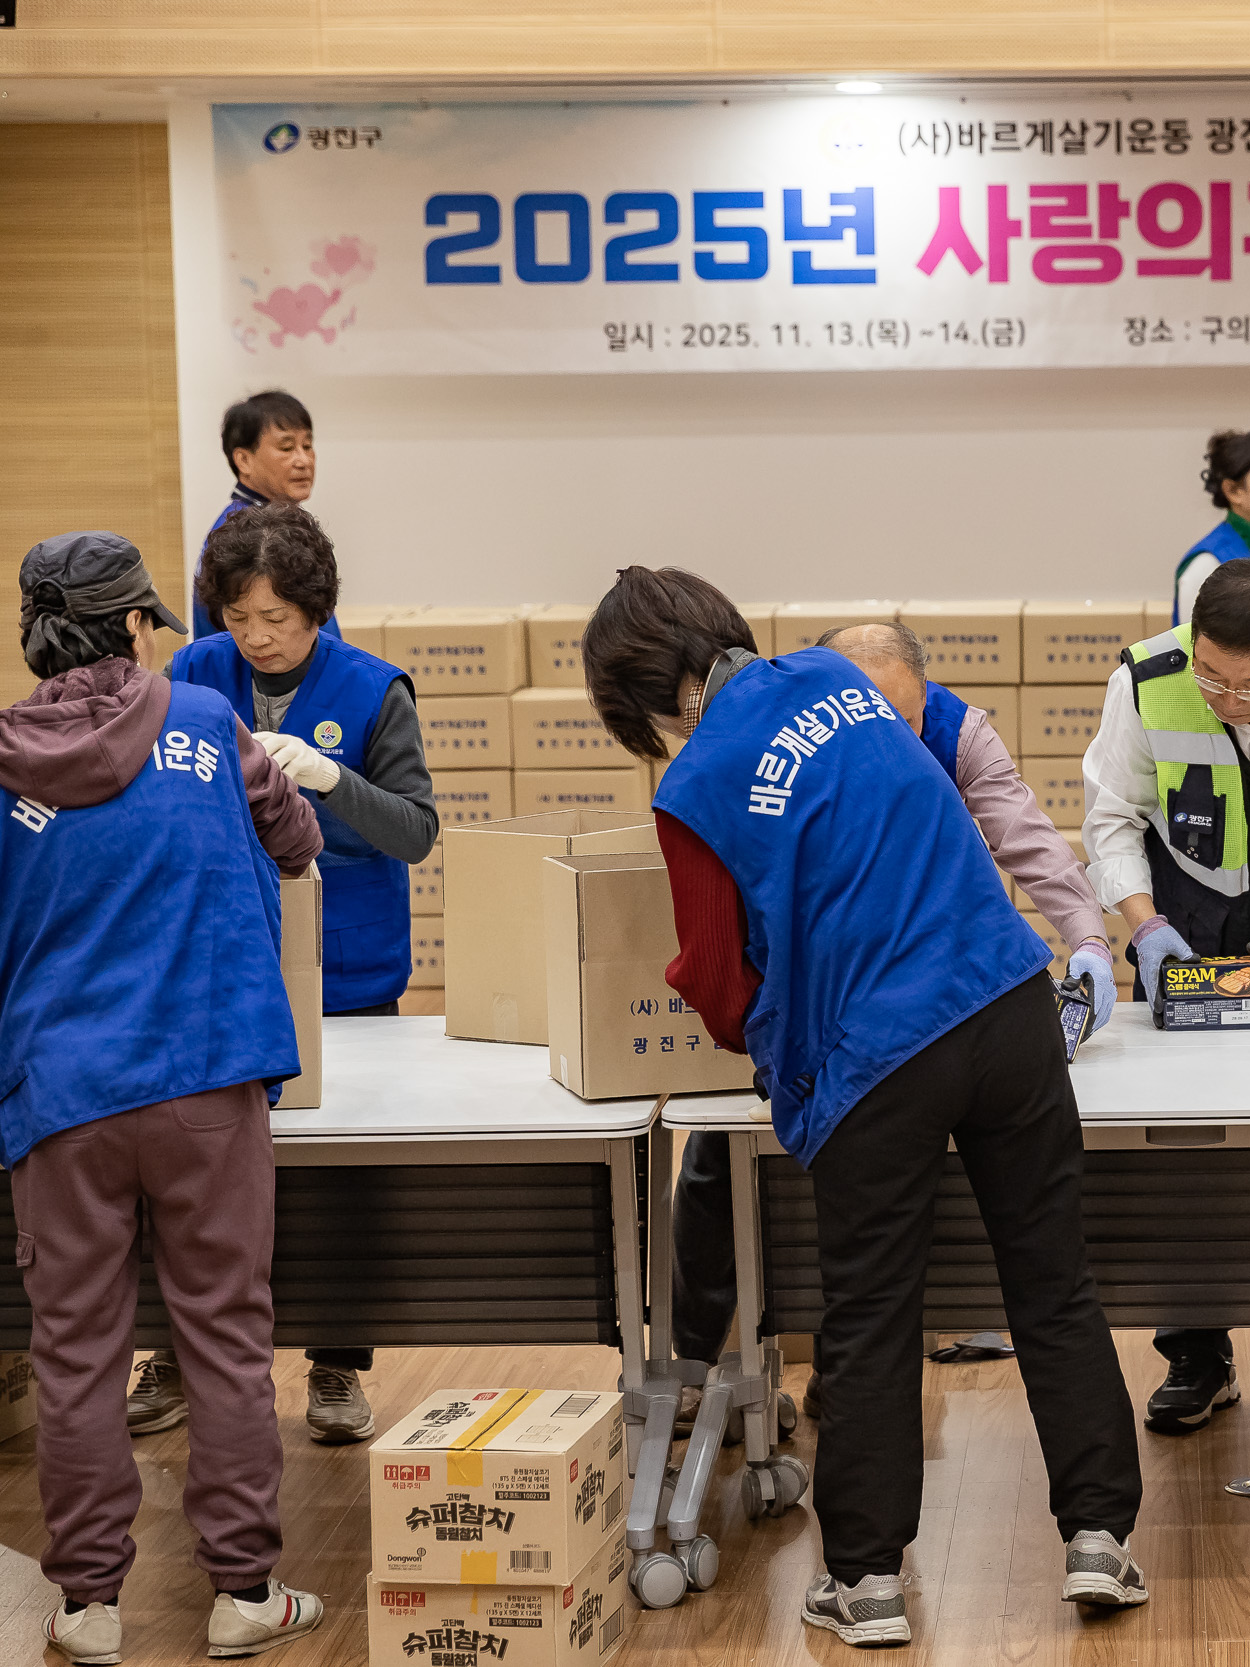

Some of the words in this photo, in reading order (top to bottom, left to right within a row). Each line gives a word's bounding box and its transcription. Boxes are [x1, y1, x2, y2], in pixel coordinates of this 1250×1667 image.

[307, 126, 382, 150] 광진구
[899, 119, 1192, 156] (사)바르게살기운동
[425, 187, 876, 285] 2025년
[602, 321, 655, 352] 일시
[681, 322, 760, 348] 2025.
[772, 322, 812, 348] 11.
[1123, 315, 1175, 346] 장소
[748, 687, 897, 817] 바르게살기운동
[1166, 967, 1217, 984] SPAM
[1167, 983, 1183, 991] 스팸
[630, 998, 659, 1017] (사)
[392, 1482, 422, 1490] 취급주의
[499, 1475, 509, 1483] BTS
[446, 1493, 470, 1502] 고단백
[523, 1491, 548, 1500] 1002123
[405, 1502, 516, 1535] 슈퍼참치
[435, 1526, 483, 1541] 동원참치
[387, 1553, 422, 1563] Dongwon
[388, 1608, 417, 1617] 취급주의
[441, 1618, 465, 1628] 고단백
[402, 1628, 509, 1662] 슈퍼참치
[431, 1652, 478, 1667] 동원참치
